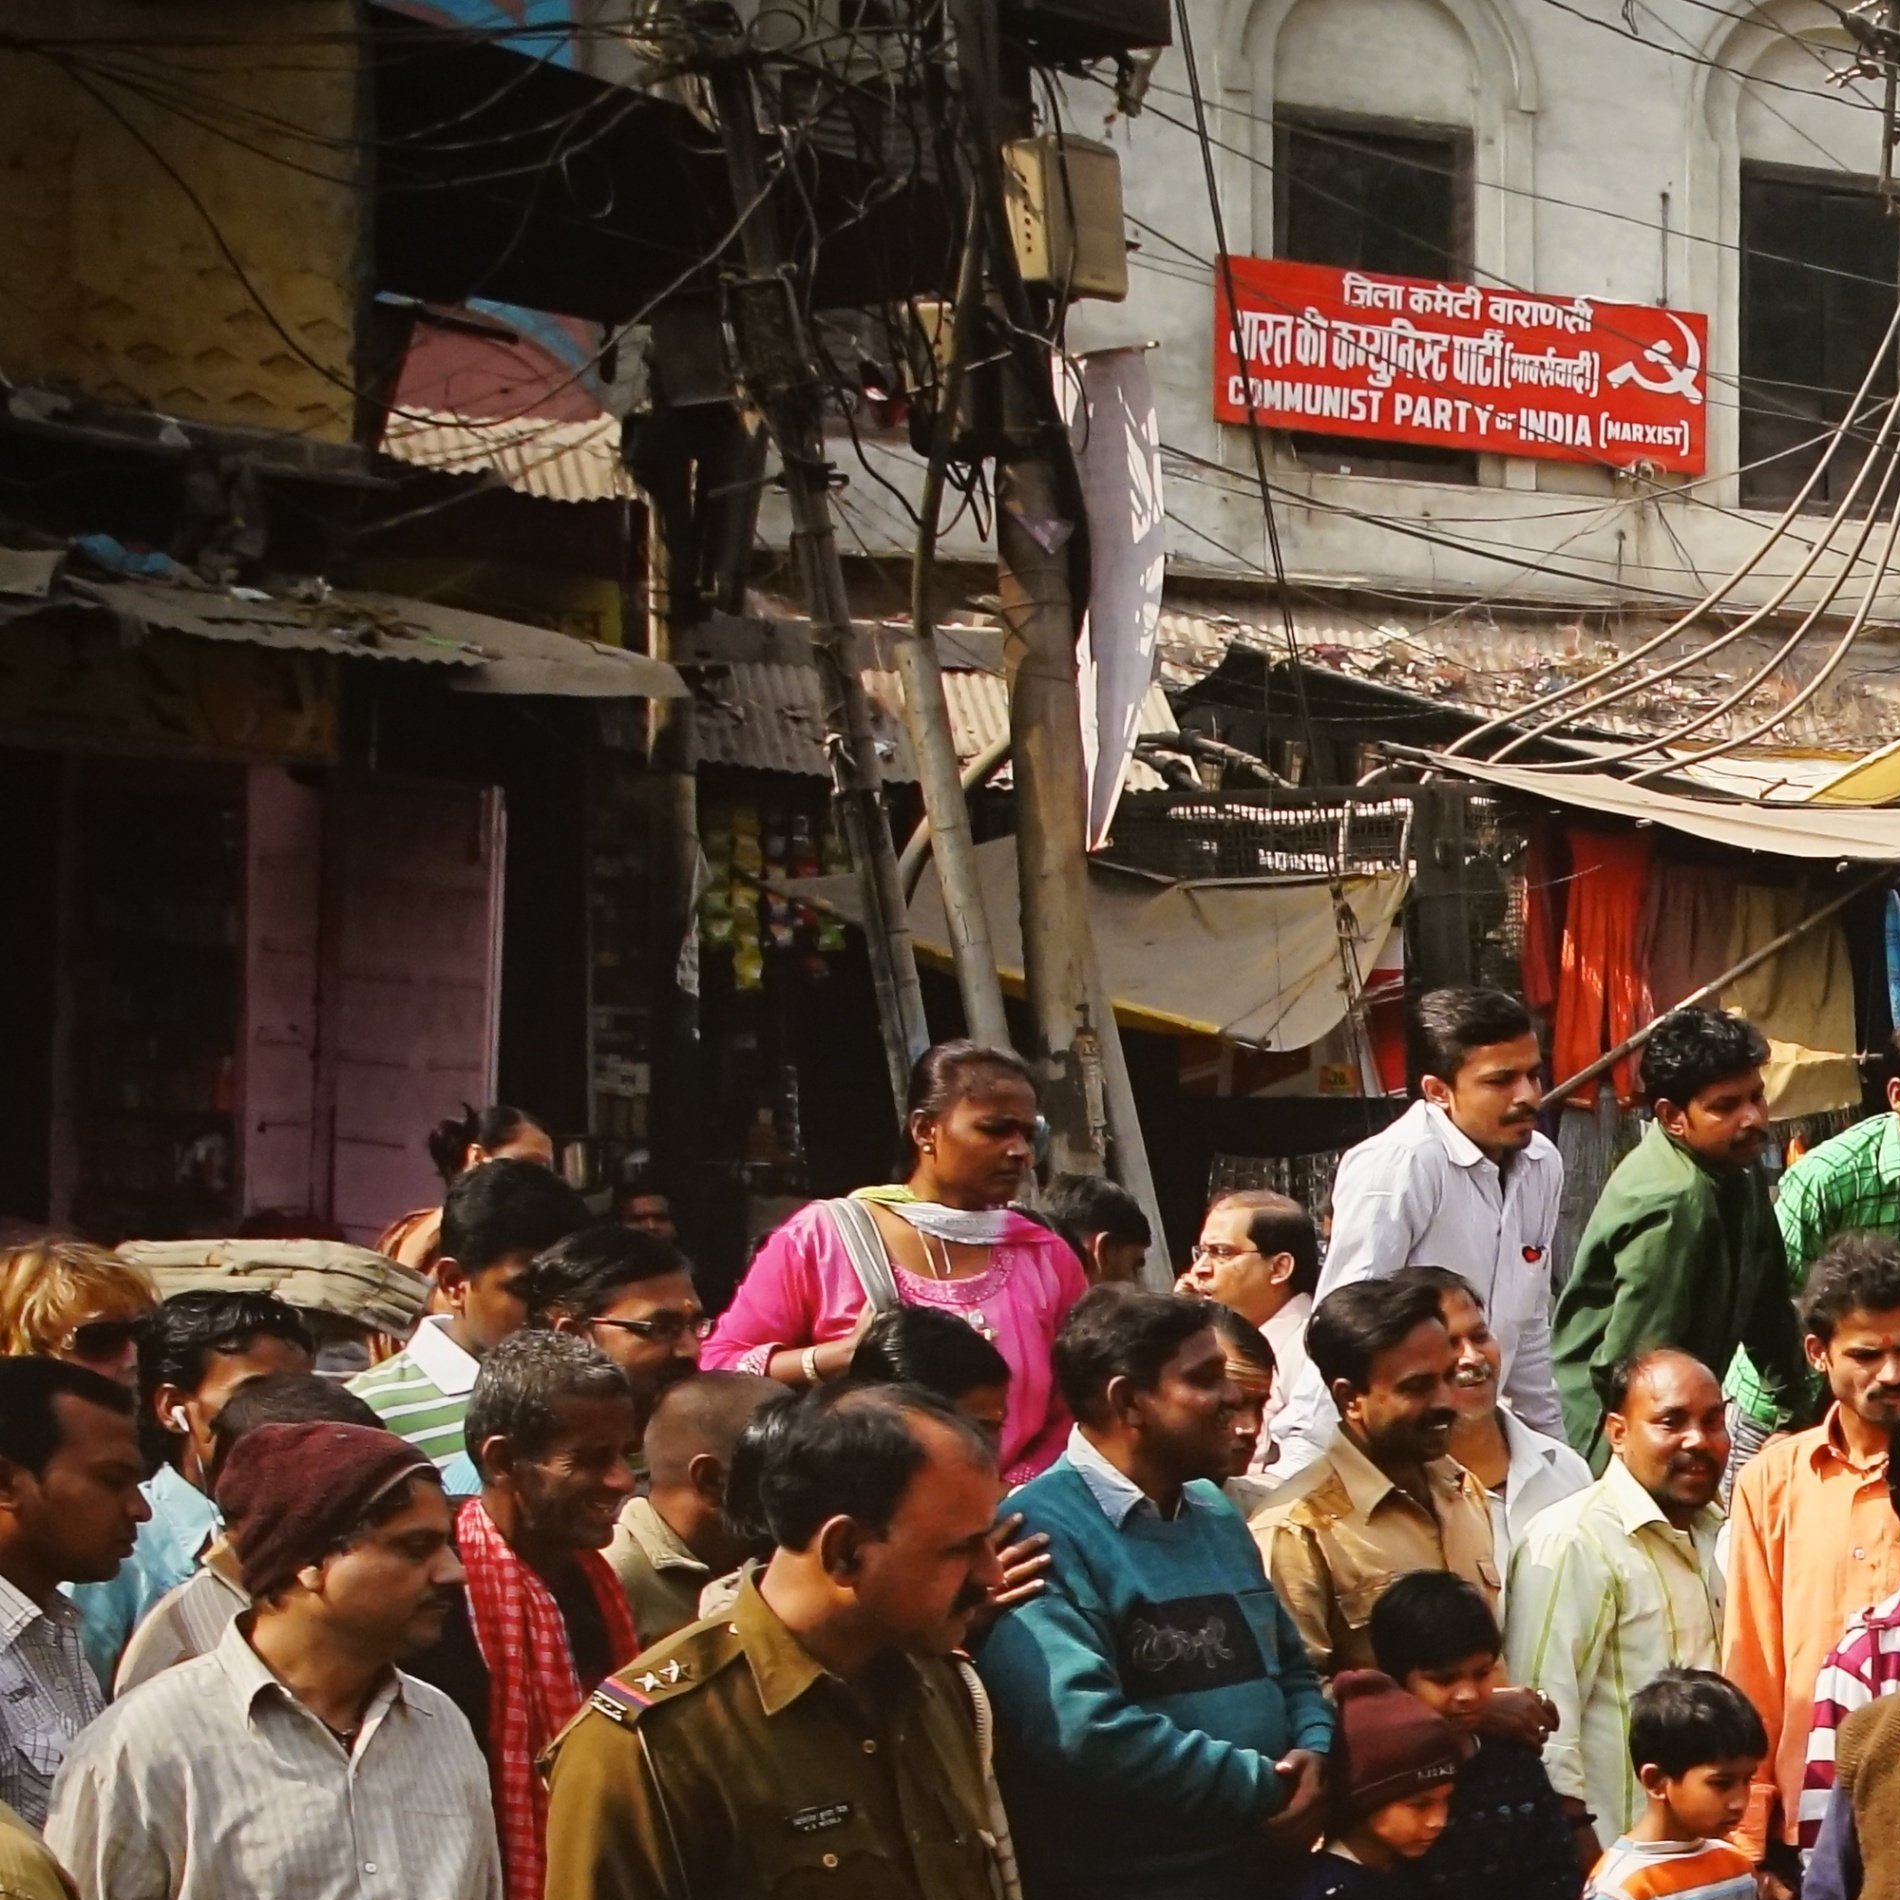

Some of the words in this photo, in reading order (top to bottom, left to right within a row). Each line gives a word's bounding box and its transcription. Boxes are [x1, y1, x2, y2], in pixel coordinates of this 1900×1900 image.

[1343, 272, 1405, 310] जिला
[1409, 284, 1483, 320] कमेटी
[1488, 296, 1593, 334] वाराणसी
[1230, 309, 1294, 368] भारत
[1295, 306, 1330, 368] की
[1452, 328, 1506, 388] पार्टी
[1228, 375, 1384, 423] COMMUNIST
[1394, 392, 1494, 435] PARTY
[1519, 407, 1592, 448] INDIA
[1600, 411, 1689, 457] (MARXIST)
